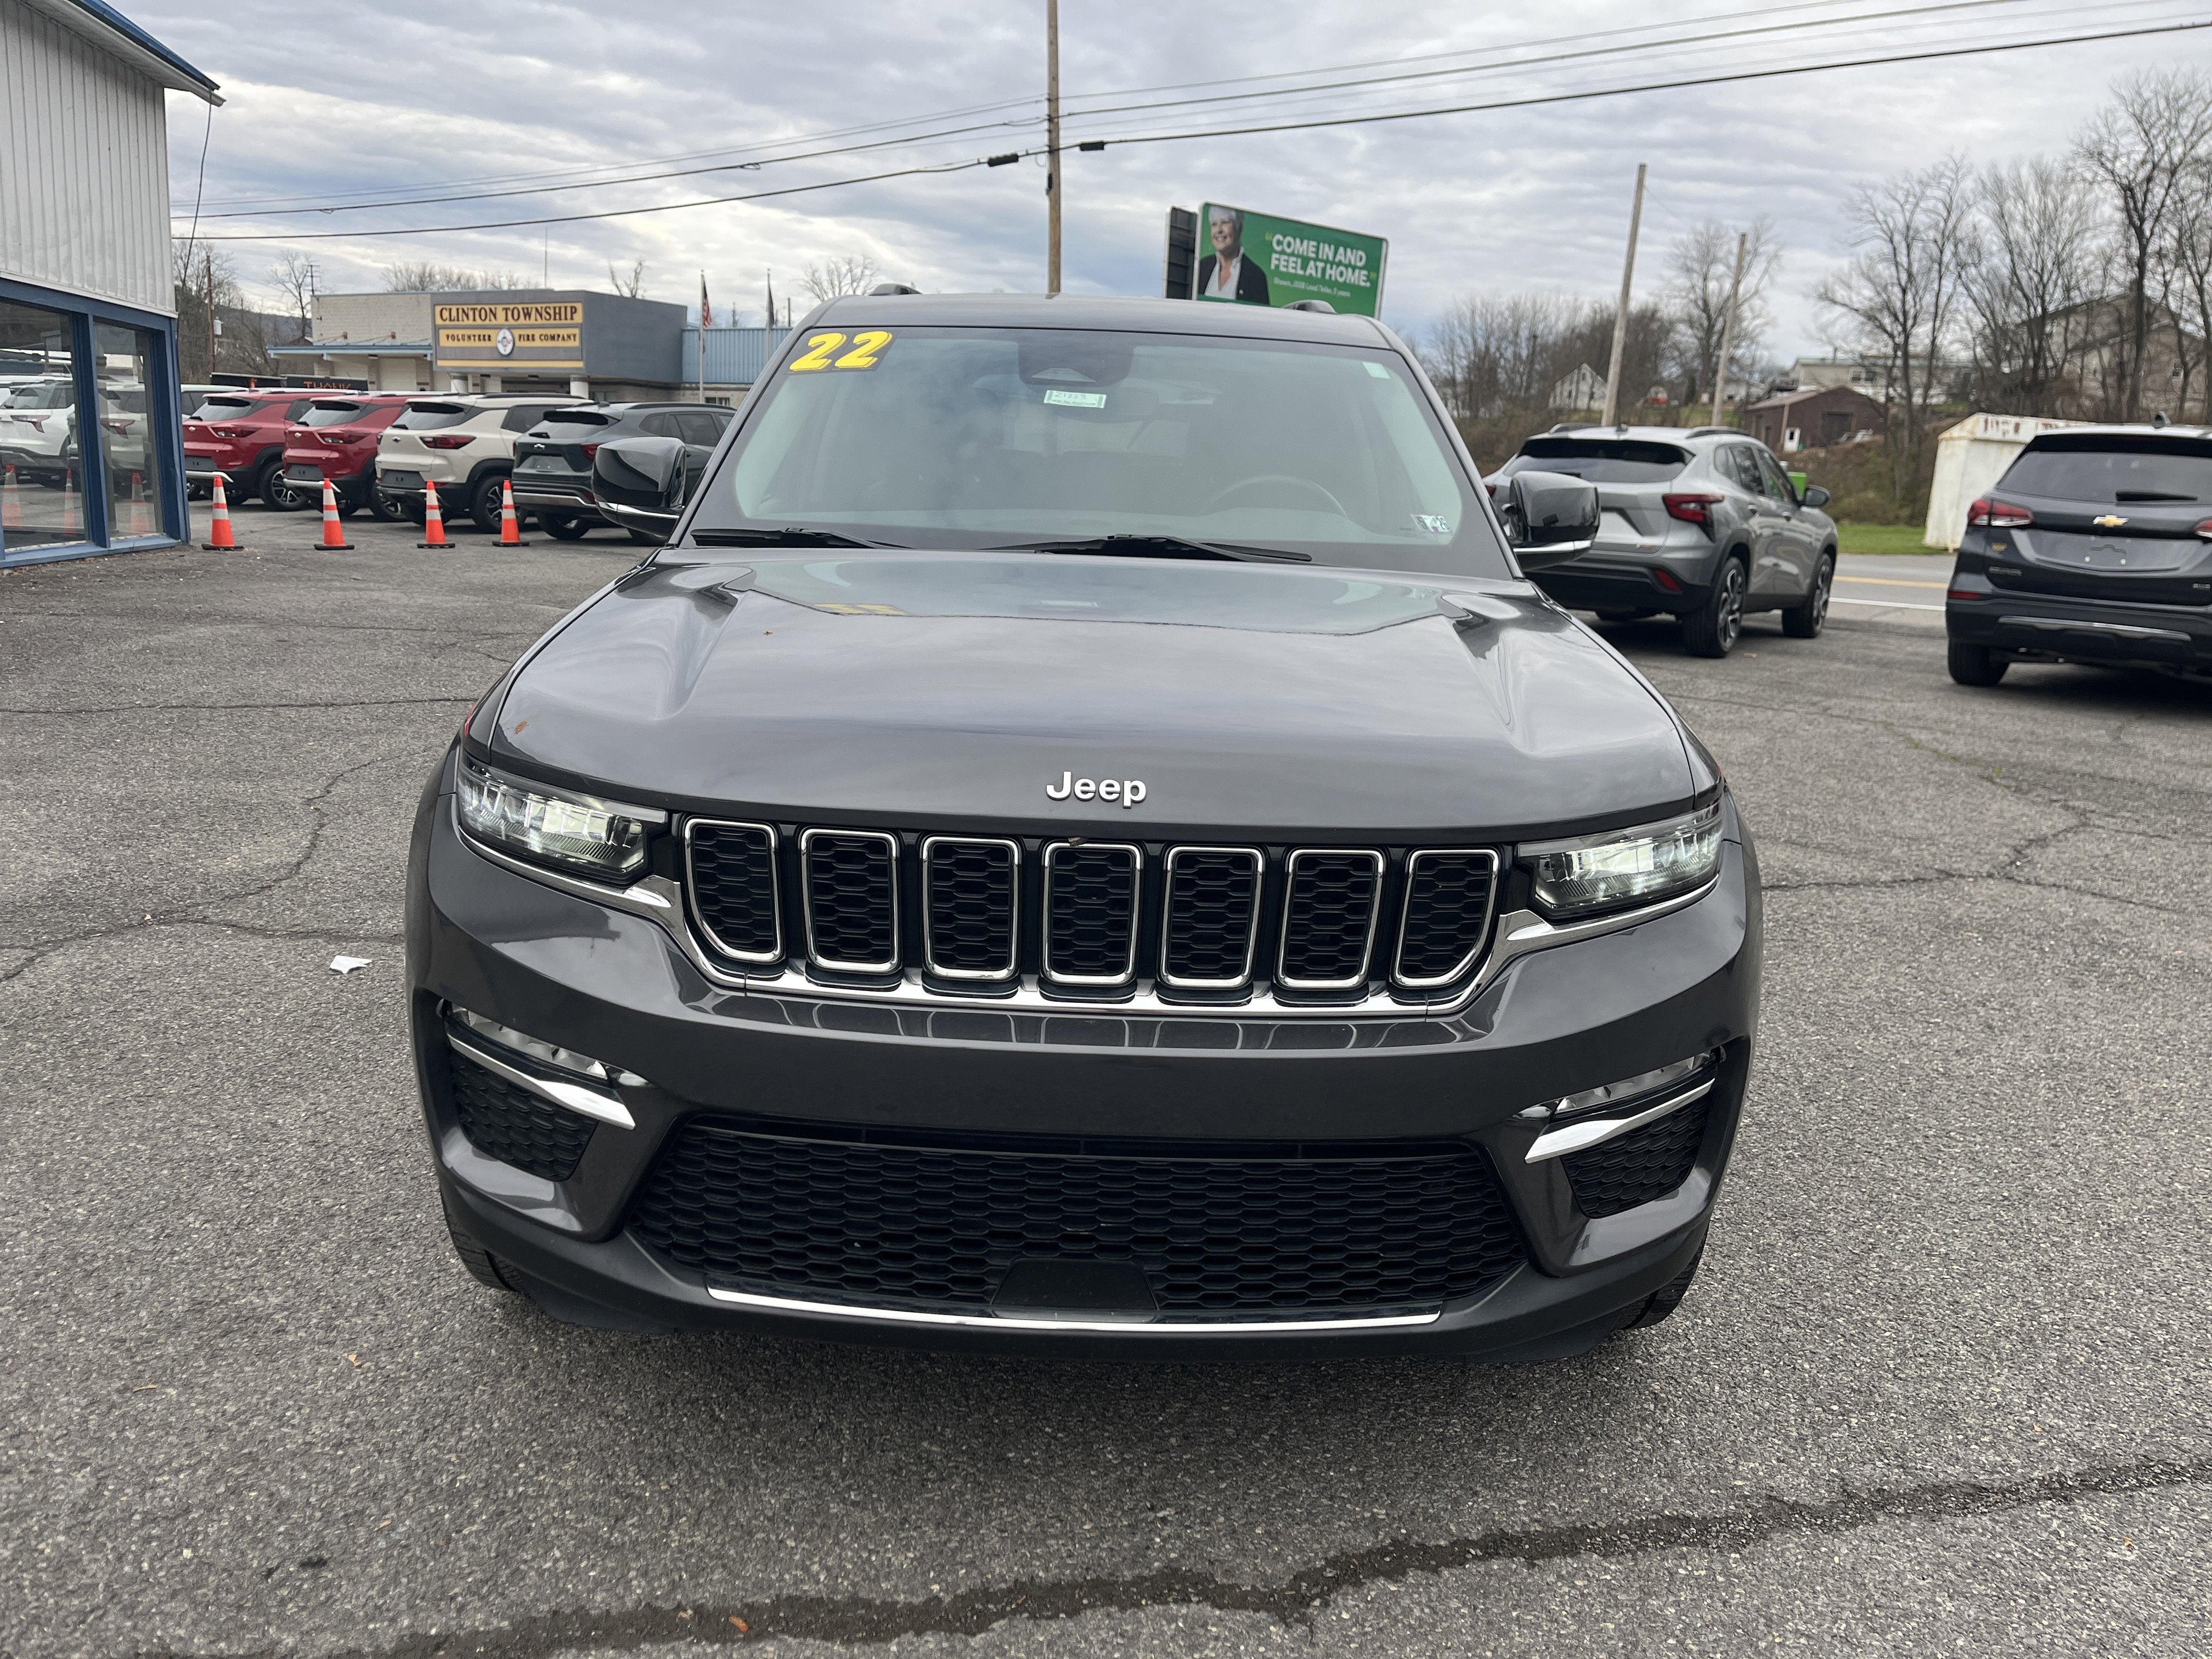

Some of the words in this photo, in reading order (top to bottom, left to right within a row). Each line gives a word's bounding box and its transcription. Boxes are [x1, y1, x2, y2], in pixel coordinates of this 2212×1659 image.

[1270, 253, 1304, 275] FEEL
[1305, 259, 1325, 279] AT
[1318, 242, 1334, 261] IN
[1334, 246, 1367, 267] AND
[439, 307, 497, 322] CLINTON
[502, 306, 578, 322] TOWNSHIP
[445, 334, 492, 342] VOLUNTEER
[518, 334, 535, 342] FIRE
[539, 333, 577, 342] COMPANY
[789, 331, 893, 371] 22
[1436, 517, 1449, 531] 26
[1046, 771, 1147, 809] Jeep
